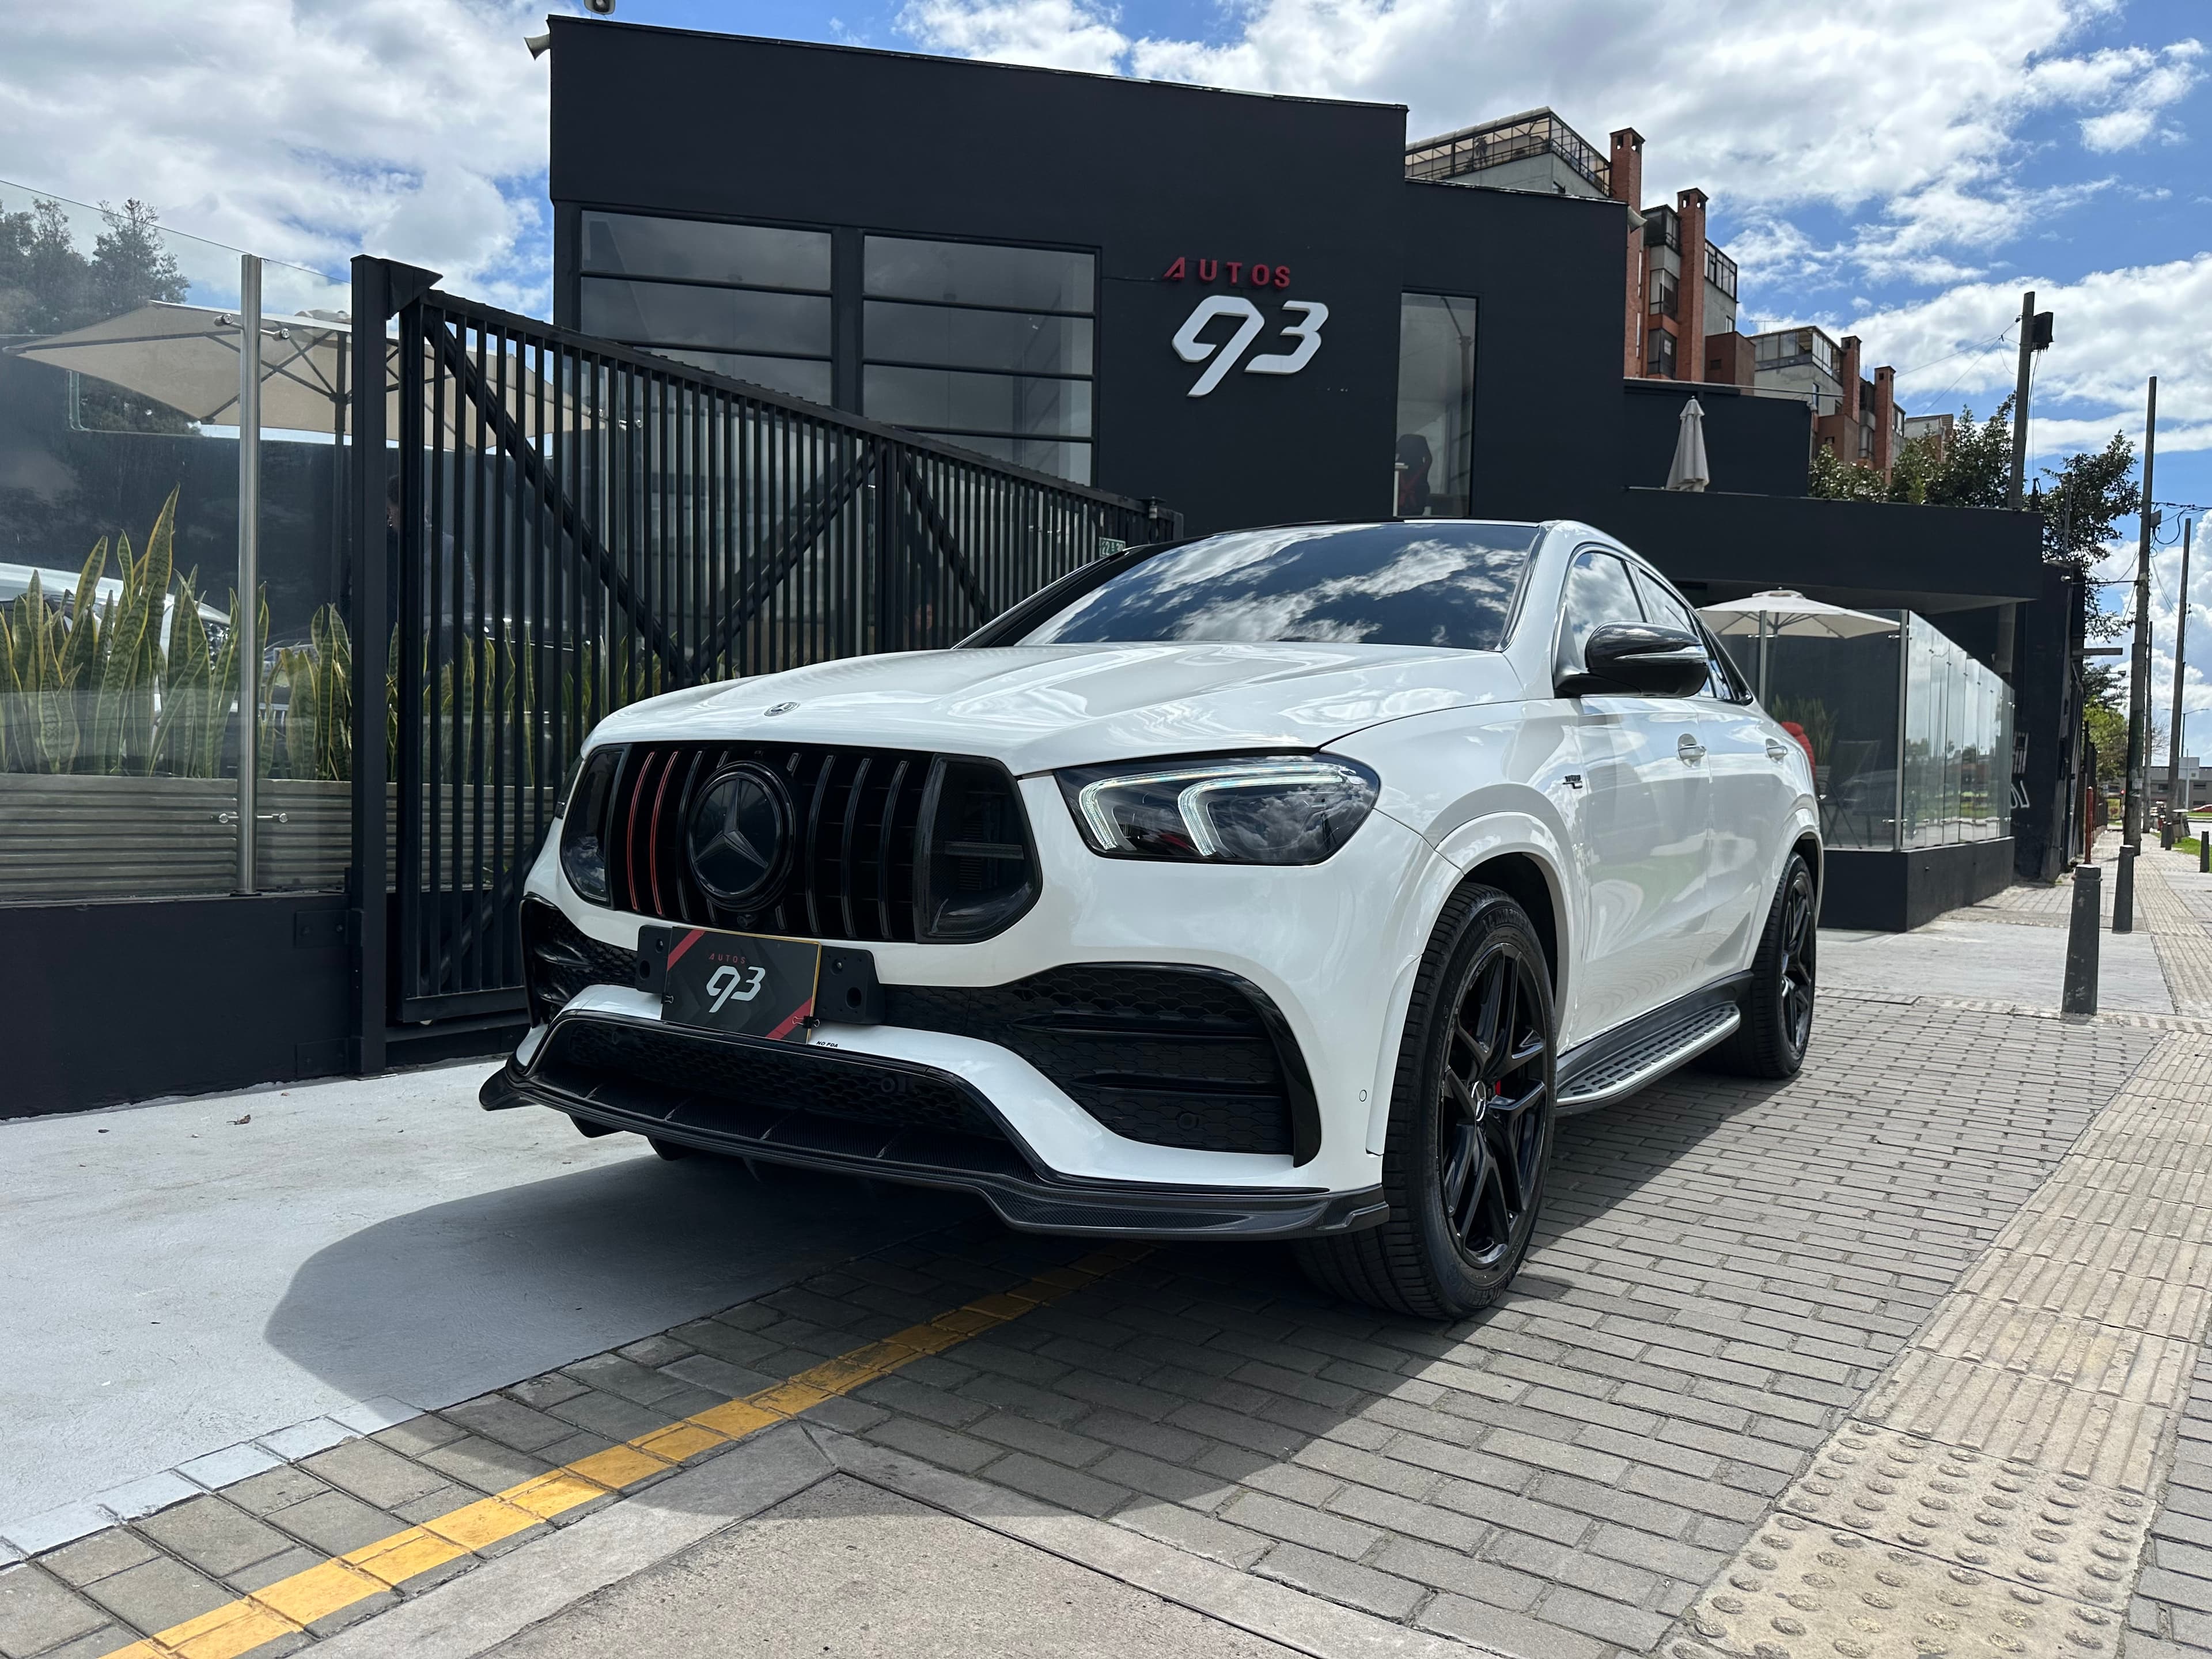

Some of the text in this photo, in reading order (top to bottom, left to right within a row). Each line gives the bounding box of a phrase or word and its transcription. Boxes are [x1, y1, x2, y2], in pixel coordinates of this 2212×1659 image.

[1162, 257, 1291, 288] AUTOS
[1172, 295, 1330, 397] 93
[709, 953, 746, 964] AUTOS
[706, 965, 766, 1013] 93
